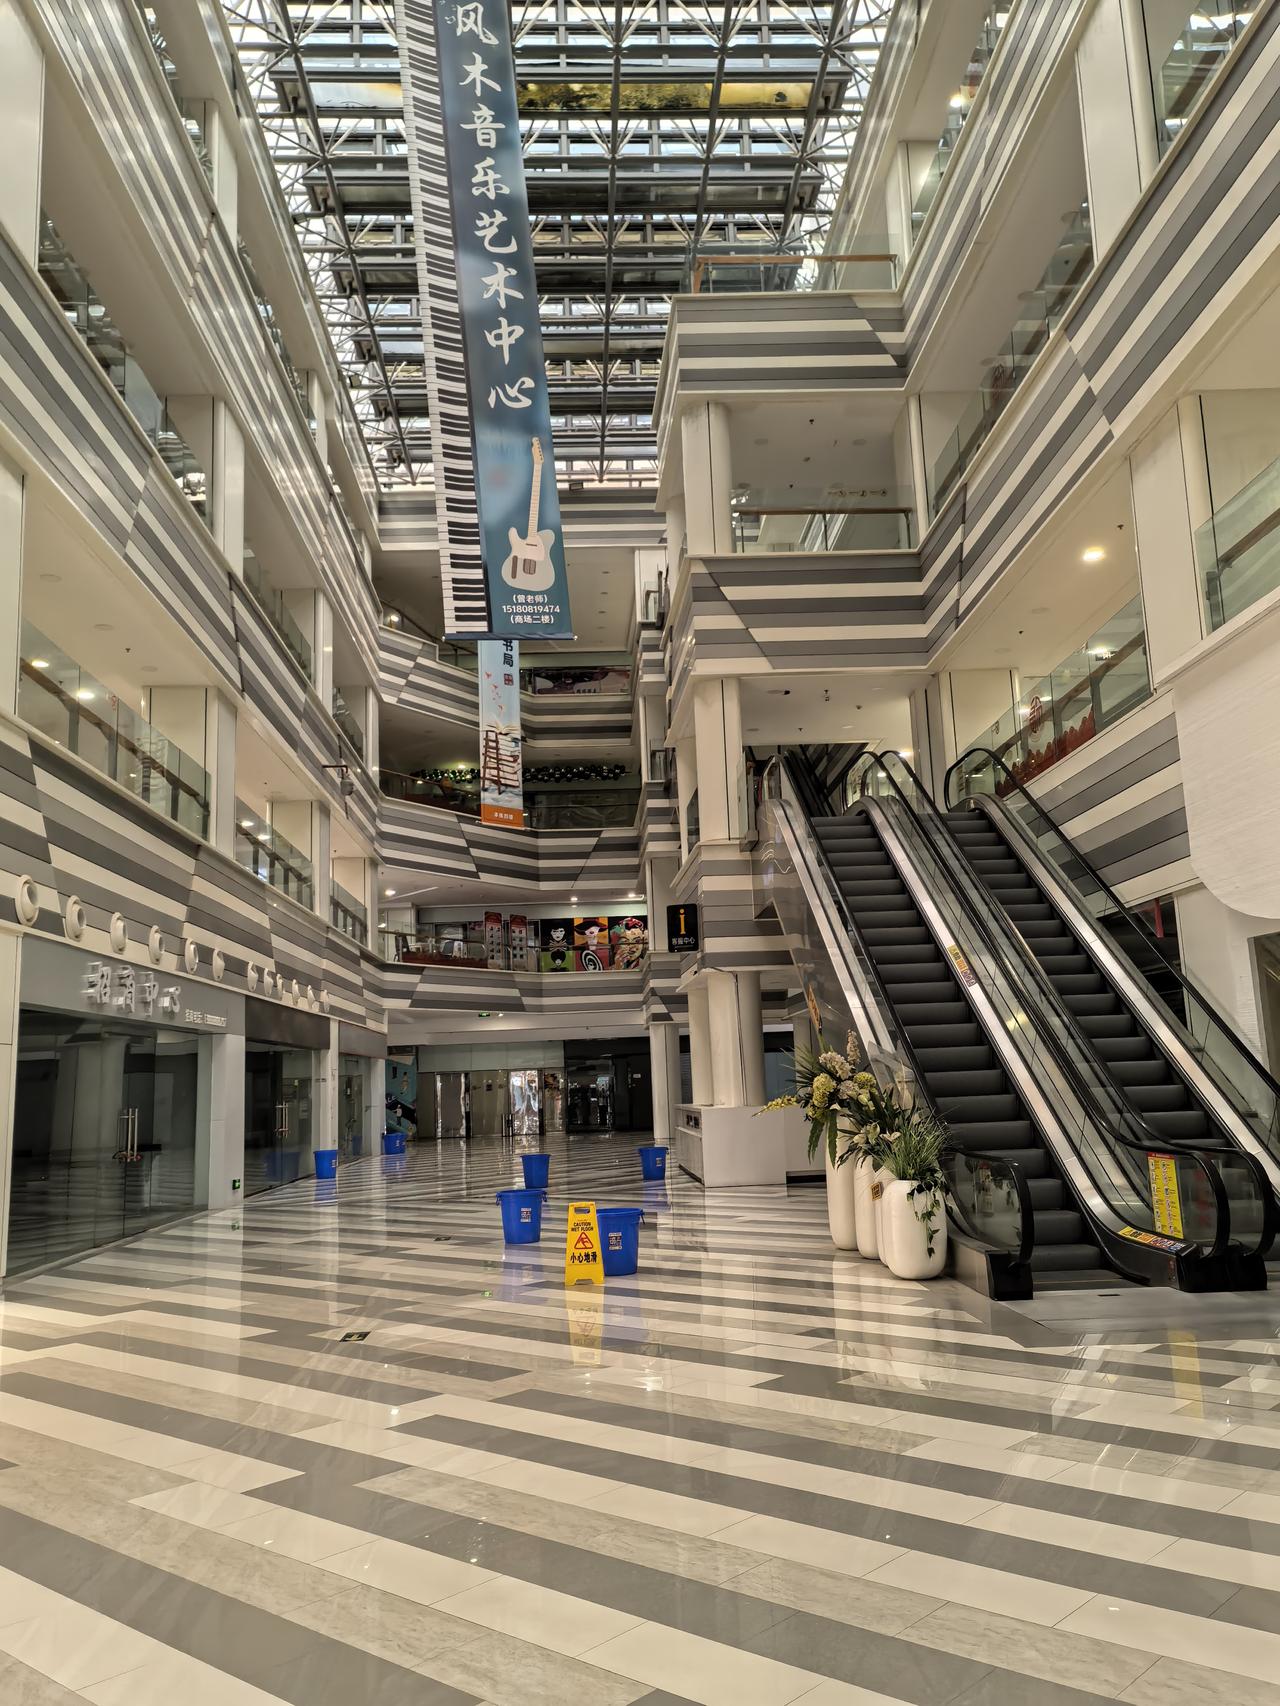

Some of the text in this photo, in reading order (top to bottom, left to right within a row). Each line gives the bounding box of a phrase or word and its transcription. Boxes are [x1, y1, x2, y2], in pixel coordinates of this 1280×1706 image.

[455, 2, 537, 408] 风木音乐艺术中心
[502, 605, 560, 613] 15180819474
[570, 1251, 598, 1263] 小心地滑
